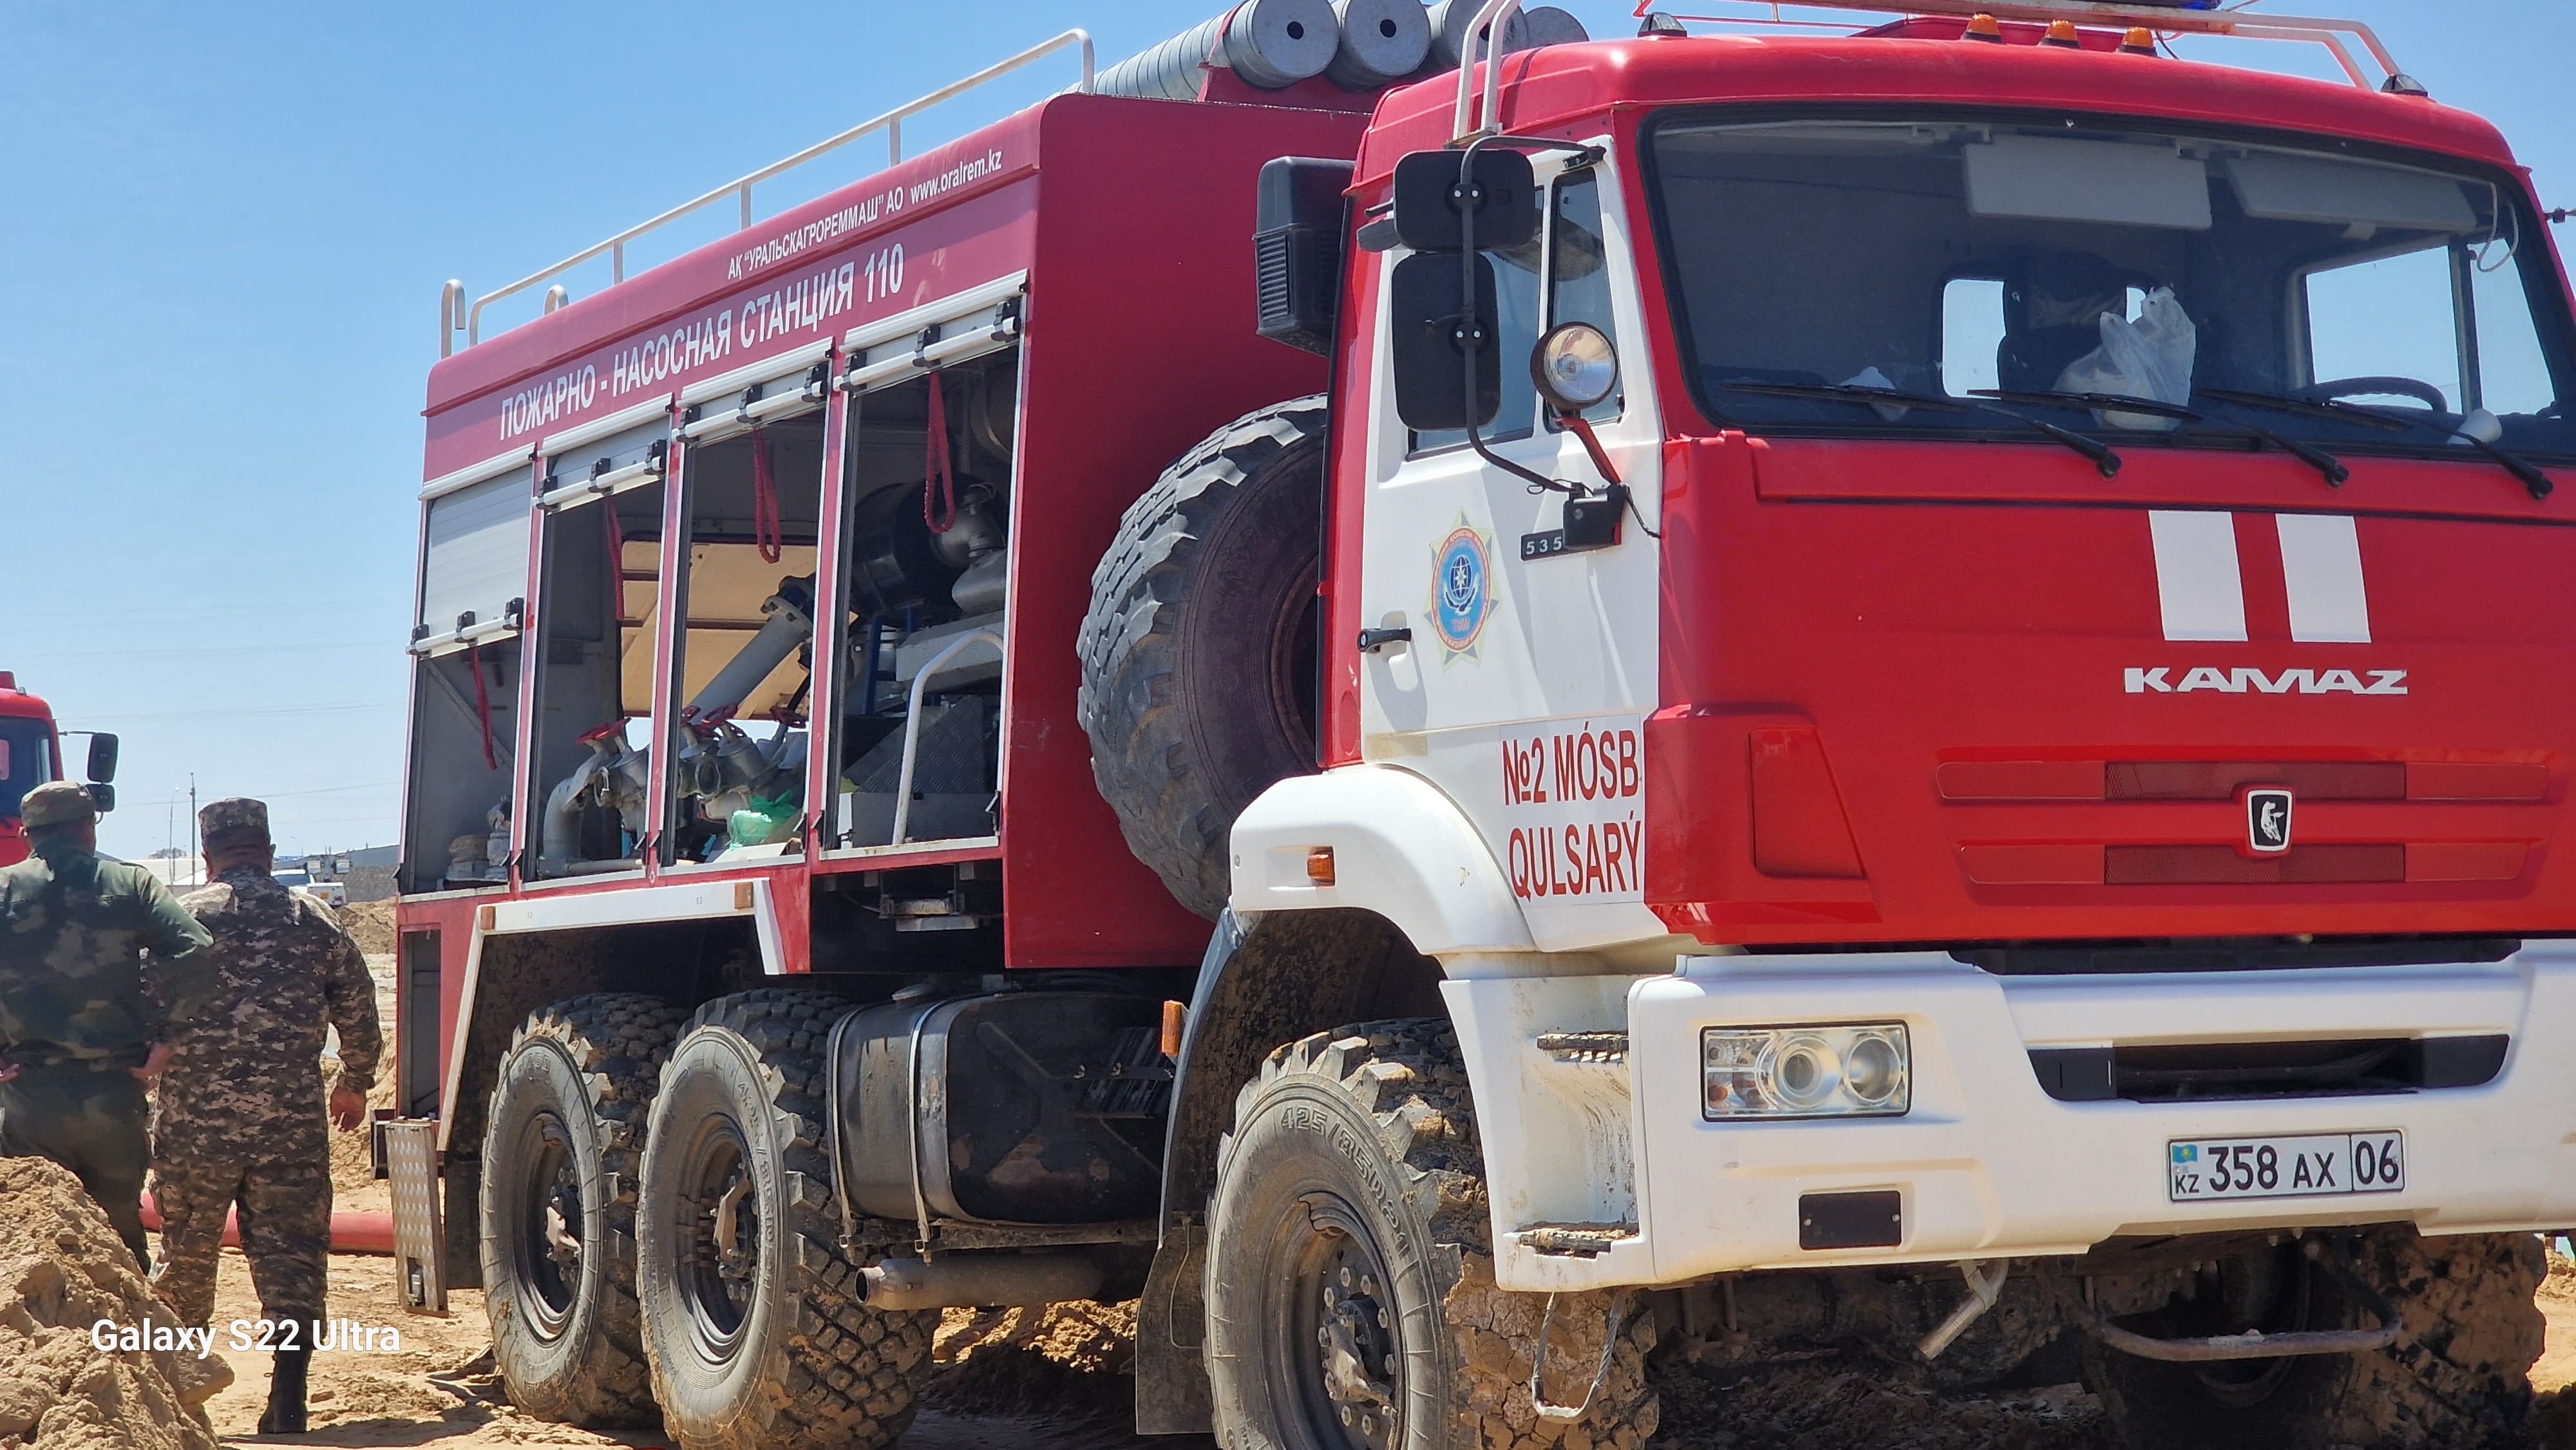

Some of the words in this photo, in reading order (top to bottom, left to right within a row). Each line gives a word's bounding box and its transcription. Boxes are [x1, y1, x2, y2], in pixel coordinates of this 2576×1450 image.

[886, 186, 904, 214] АО
[911, 148, 1001, 205] www.oralrem.kz
[500, 364, 596, 440] ПОЖАРНО
[612, 309, 732, 397] НАСОСНАЯ
[741, 261, 855, 348] СТАНЦИЯ
[864, 243, 904, 303] 110
[2123, 666, 2409, 695] KAMAZ
[1502, 737, 1547, 805] №2
[1554, 721, 1638, 801] MÓSB
[1509, 810, 1642, 903] QULSARÝ
[2175, 1174, 2200, 1194] KZ
[2208, 1144, 2278, 1192] 358
[2292, 1151, 2336, 1189] AX
[2355, 1139, 2400, 1185] 06
